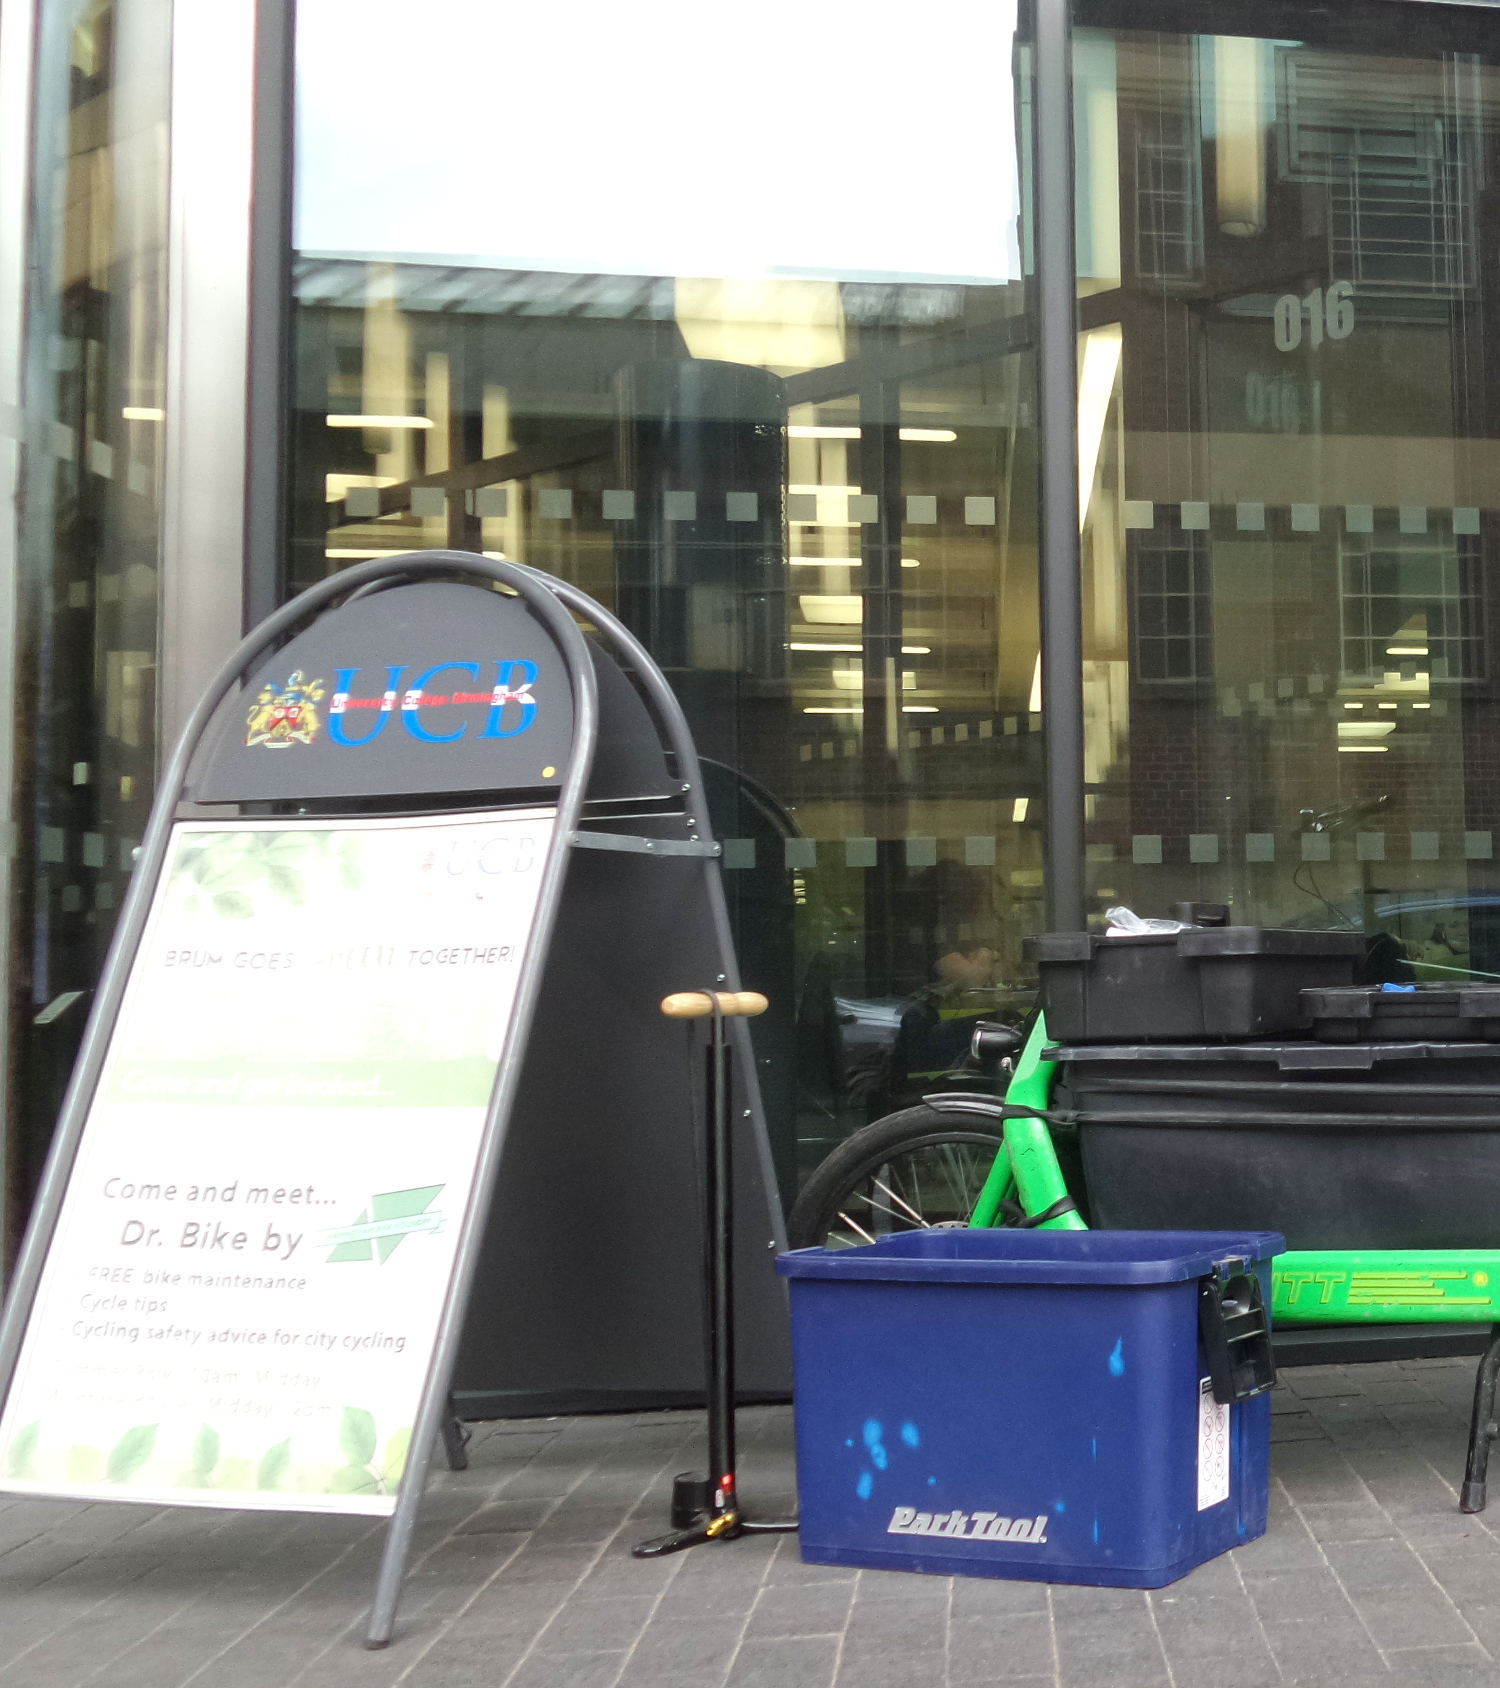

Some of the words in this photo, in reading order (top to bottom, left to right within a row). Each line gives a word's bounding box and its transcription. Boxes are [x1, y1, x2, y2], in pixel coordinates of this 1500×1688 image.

[1274, 281, 1355, 352] 016
[327, 659, 539, 747] UCB
[165, 950, 223, 968] BRUM
[234, 951, 293, 969] GOES
[408, 945, 516, 966] TOGETHER!
[122, 1070, 187, 1095] Come
[194, 1071, 239, 1096] and
[104, 1177, 178, 1202] Come
[187, 1180, 239, 1203] and
[246, 1184, 336, 1206] meet...
[119, 1220, 163, 1248] Dr.
[179, 1222, 248, 1252] Bike
[262, 1224, 303, 1261] by
[87, 1266, 134, 1285] FREE
[143, 1268, 181, 1287] bike
[188, 1273, 307, 1291] maintenance
[79, 1294, 127, 1315] Cycle
[134, 1296, 168, 1316] tips
[71, 1320, 140, 1344] Cycling
[147, 1324, 201, 1345] safety
[207, 1327, 267, 1346] advice
[273, 1329, 299, 1347] for
[304, 1331, 338, 1351] city
[342, 1333, 407, 1354] cycling
